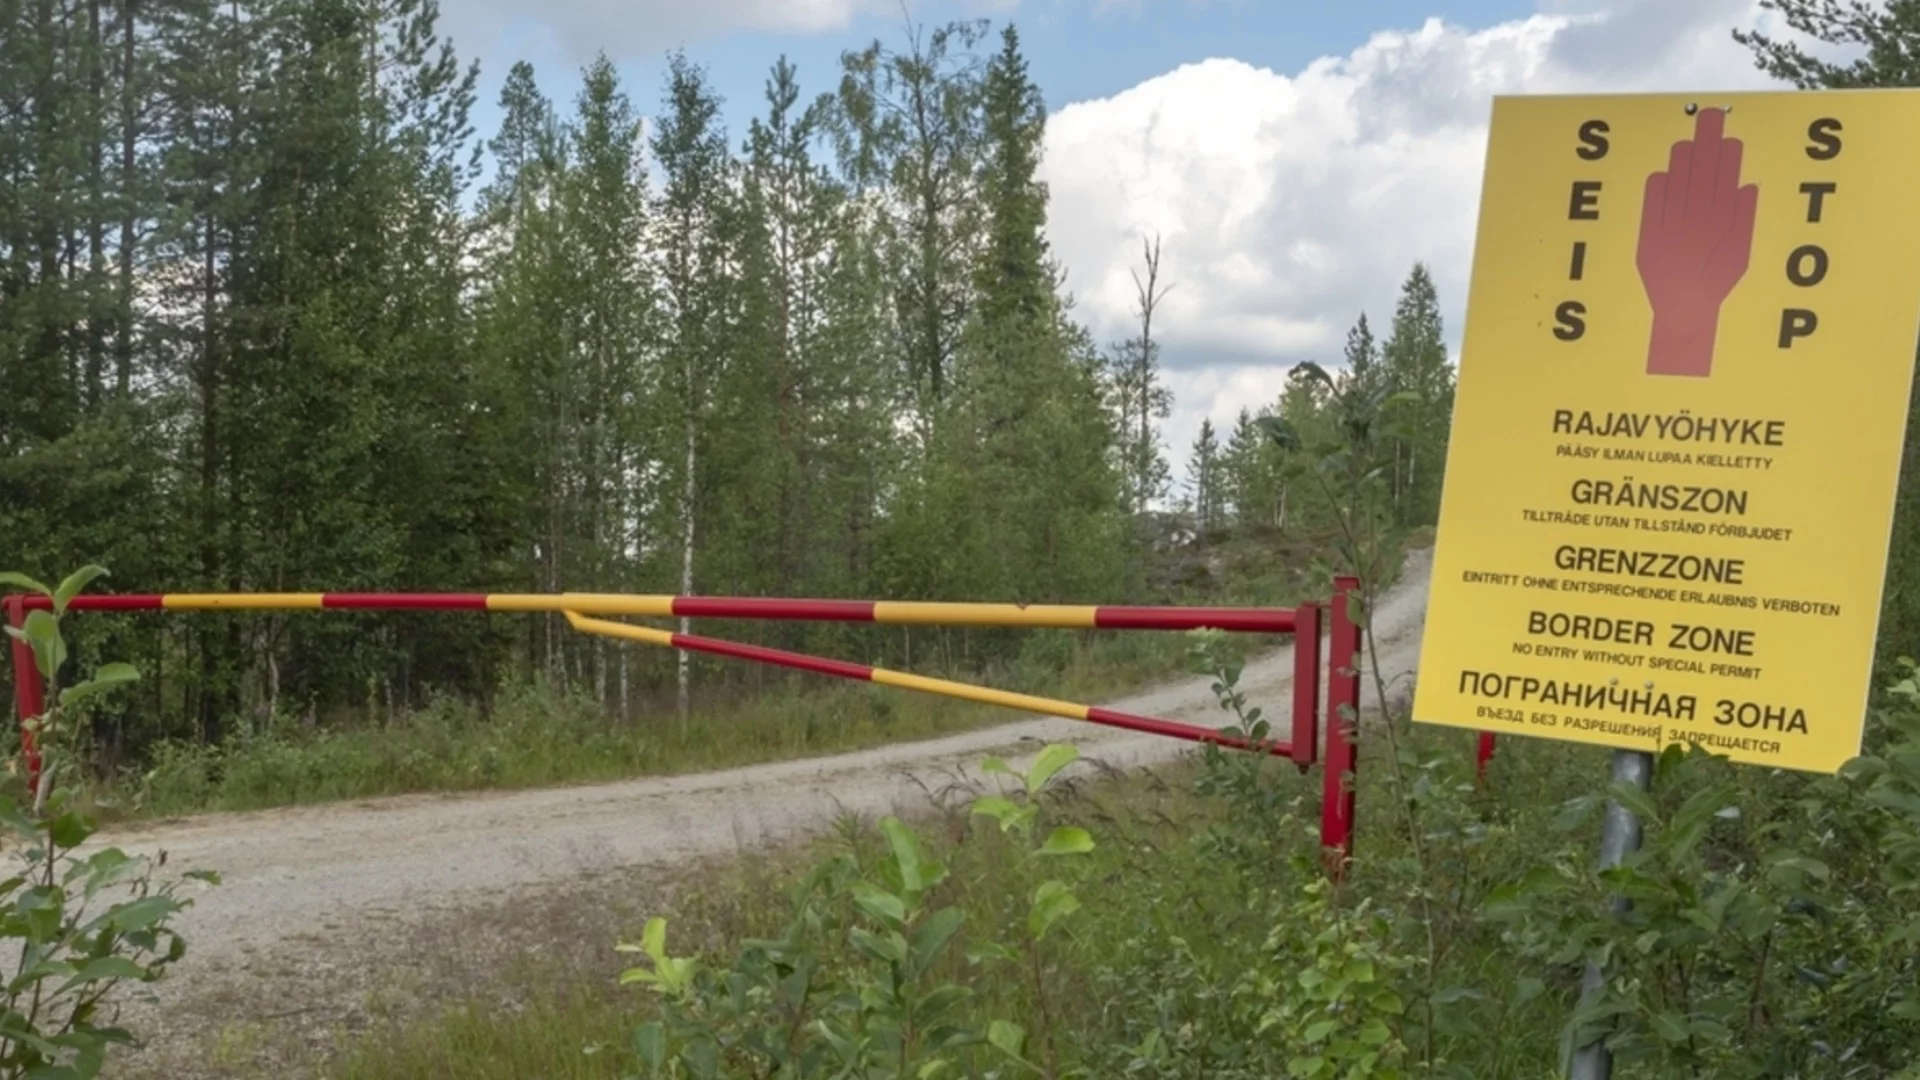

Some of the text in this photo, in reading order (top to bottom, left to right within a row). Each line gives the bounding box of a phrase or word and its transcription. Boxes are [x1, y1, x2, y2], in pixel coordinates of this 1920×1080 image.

[1552, 119, 1610, 341] SEIS
[1778, 118, 1843, 348] STOP
[1552, 409, 1785, 446] RAJAVYÖHYKE
[1556, 444, 1773, 470] PÄÄSY ILMAN LUPAA KIELLETTY
[1571, 476, 1748, 515] GRÄNSZON
[1594, 515, 1630, 529] UTAN
[1633, 517, 1706, 535] TILLSTÅND
[1708, 523, 1792, 541] FÖRBJUDET
[1554, 545, 1745, 584] GRENZZONE
[1462, 570, 1841, 616] EINTRITT OHNE ENTSPRECHENDE ERLAUBNIS VERBOTEN
[1528, 611, 1755, 656] BORDER ZONE
[1512, 642, 1762, 680] NO ENTRY WITHOUT SPECIAL PERMIT
[1459, 670, 1808, 735] ПОГРАНИЧНАЯ ЗОНА
[1476, 705, 1781, 754] ВЪЕЗД БЕЗ РАЗРЕШЕНИЯ ЗАПРЕЩАЕТСЯ
